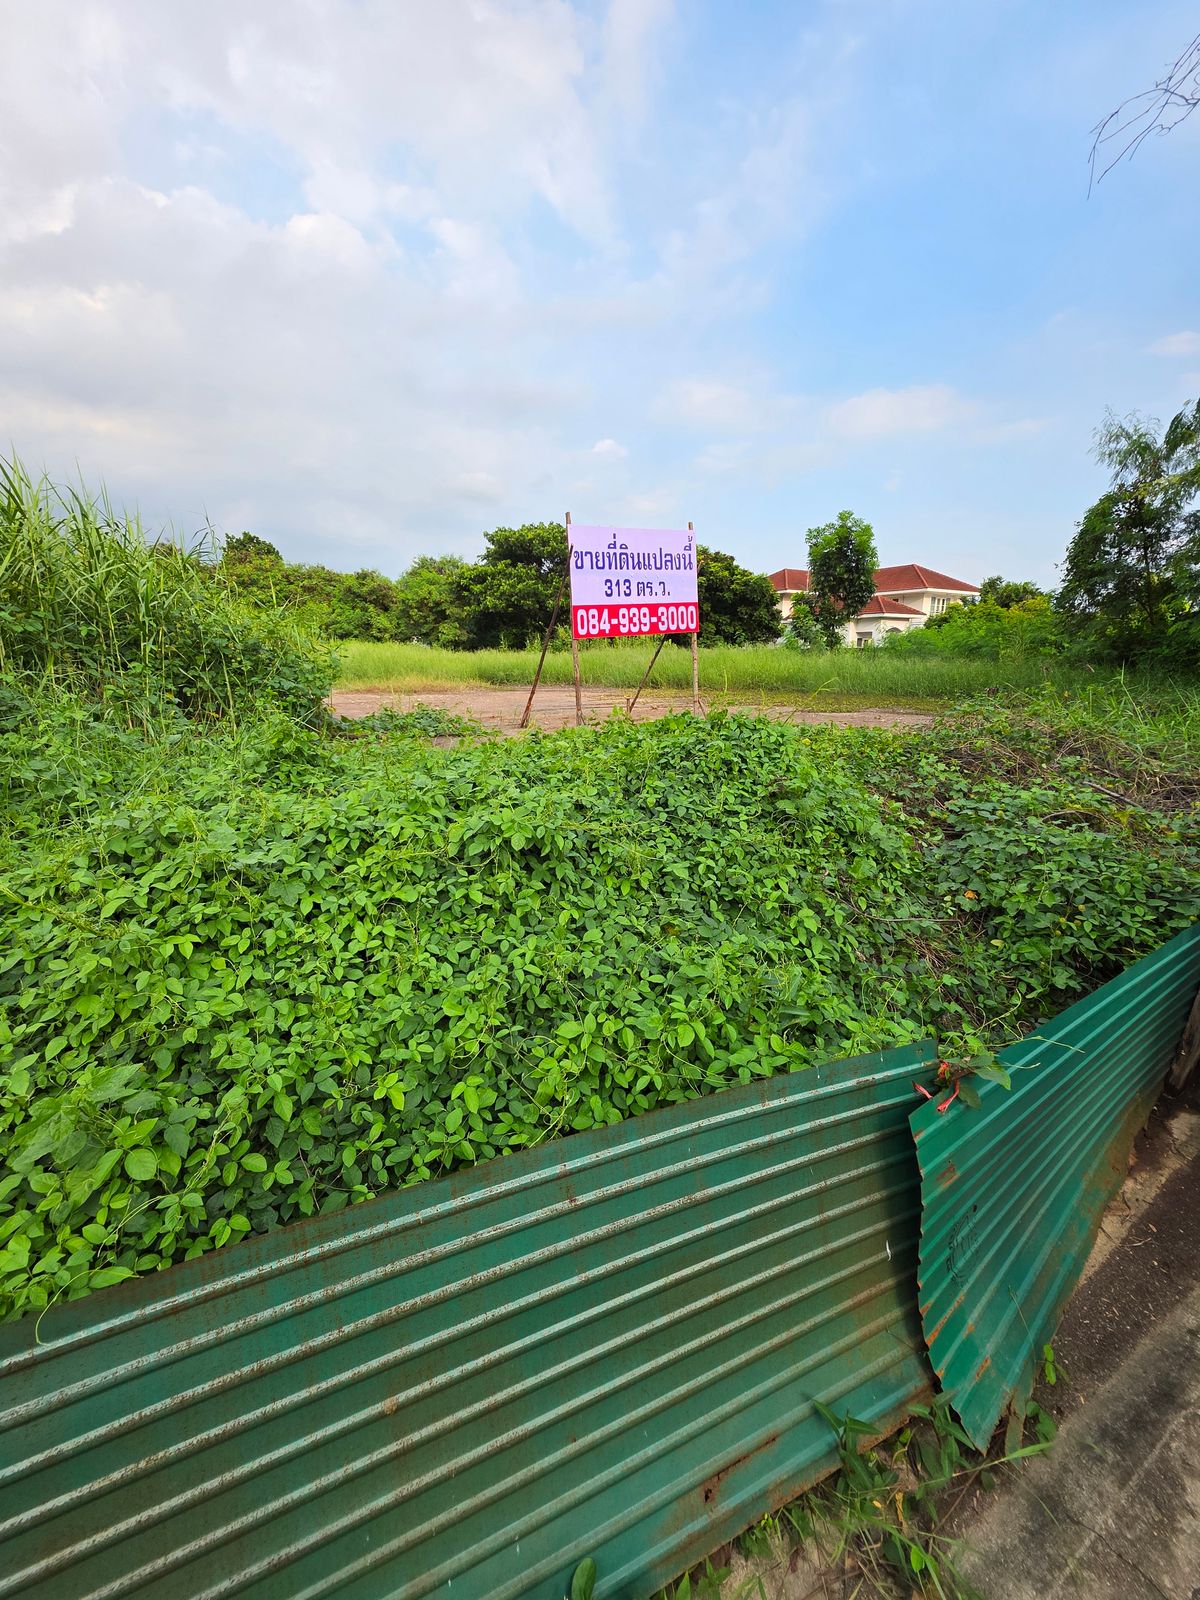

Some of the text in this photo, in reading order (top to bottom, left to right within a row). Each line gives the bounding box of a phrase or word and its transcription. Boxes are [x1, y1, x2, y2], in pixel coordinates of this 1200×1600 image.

[573, 533, 693, 570] ขายที่ดินแปลงนี้
[604, 579, 671, 597] 313 ตร.ว.
[577, 605, 697, 635] 084-939-3000
